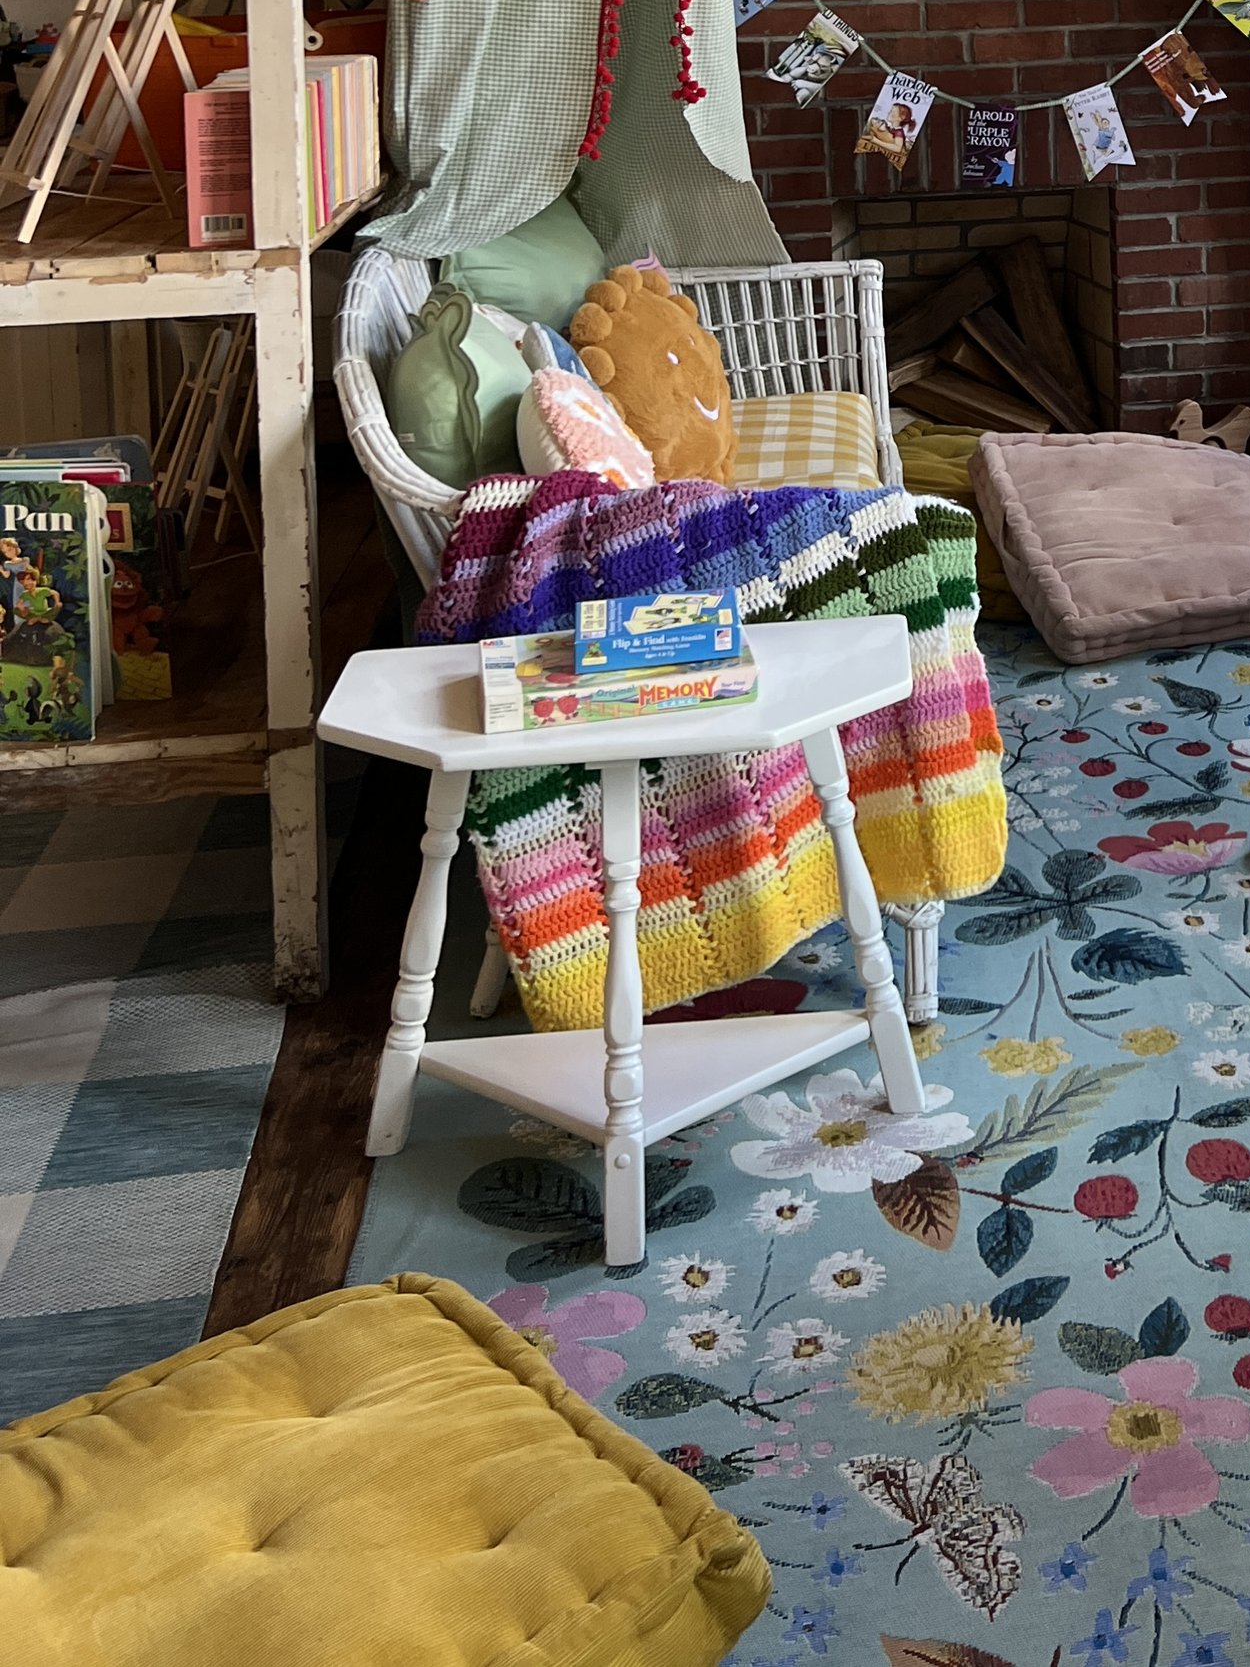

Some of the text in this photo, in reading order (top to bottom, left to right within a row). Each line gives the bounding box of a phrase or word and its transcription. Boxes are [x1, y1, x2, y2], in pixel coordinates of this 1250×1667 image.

[890, 71, 935, 97] harlott
[891, 87, 921, 106] Web
[3, 504, 75, 534] Pan
[612, 639, 631, 650] Flip
[633, 638, 640, 646] &
[644, 635, 665, 646] Find
[596, 685, 636, 699] Original
[638, 675, 721, 707] MEMORY
